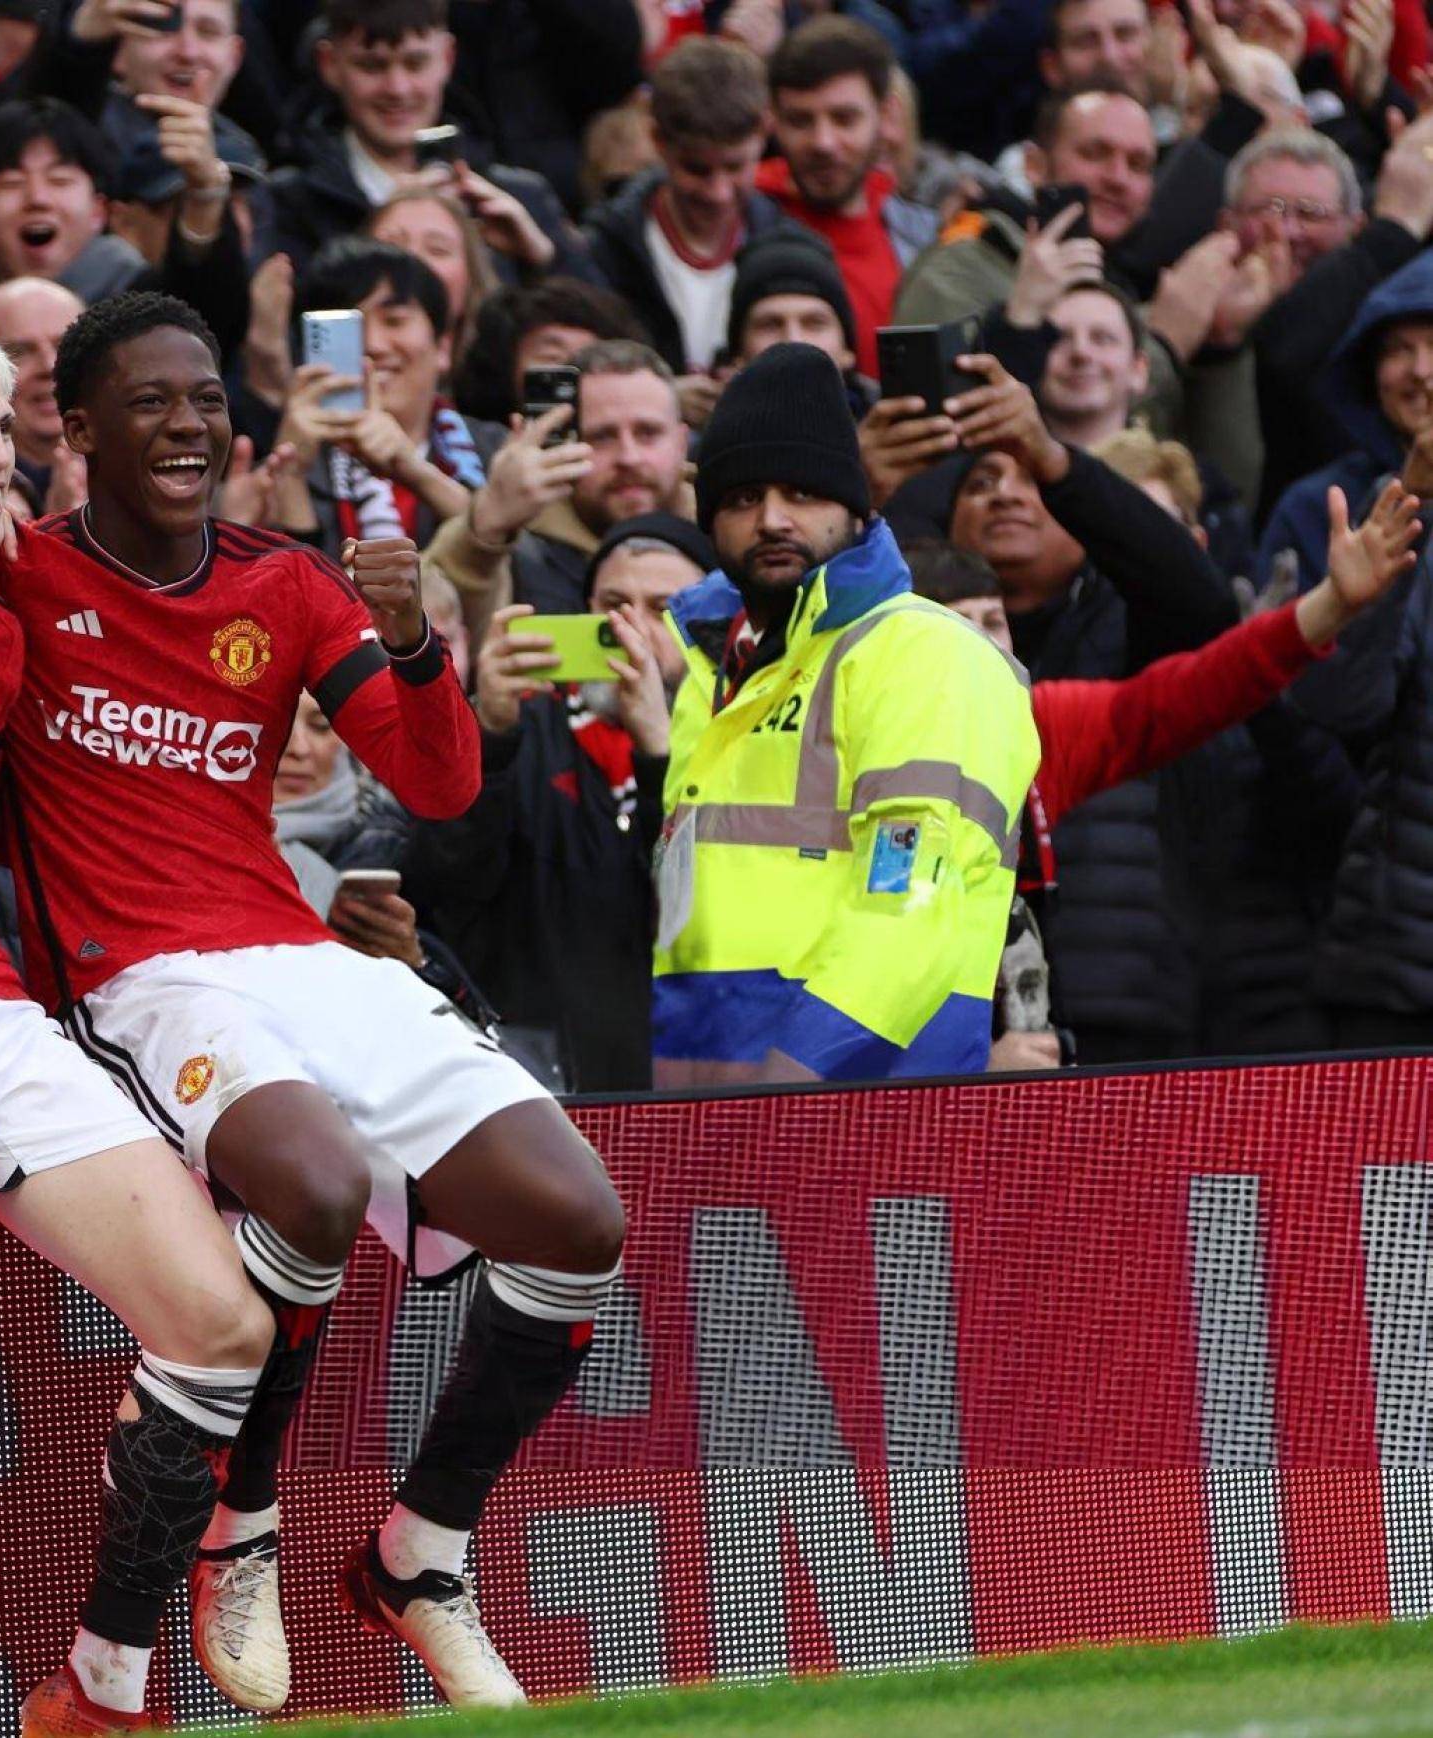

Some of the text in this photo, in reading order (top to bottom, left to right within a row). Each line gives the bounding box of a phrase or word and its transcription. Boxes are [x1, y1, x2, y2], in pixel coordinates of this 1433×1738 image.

[222, 669, 257, 682] UNITED
[37, 699, 202, 773] Viewer
[71, 684, 207, 746] Team
